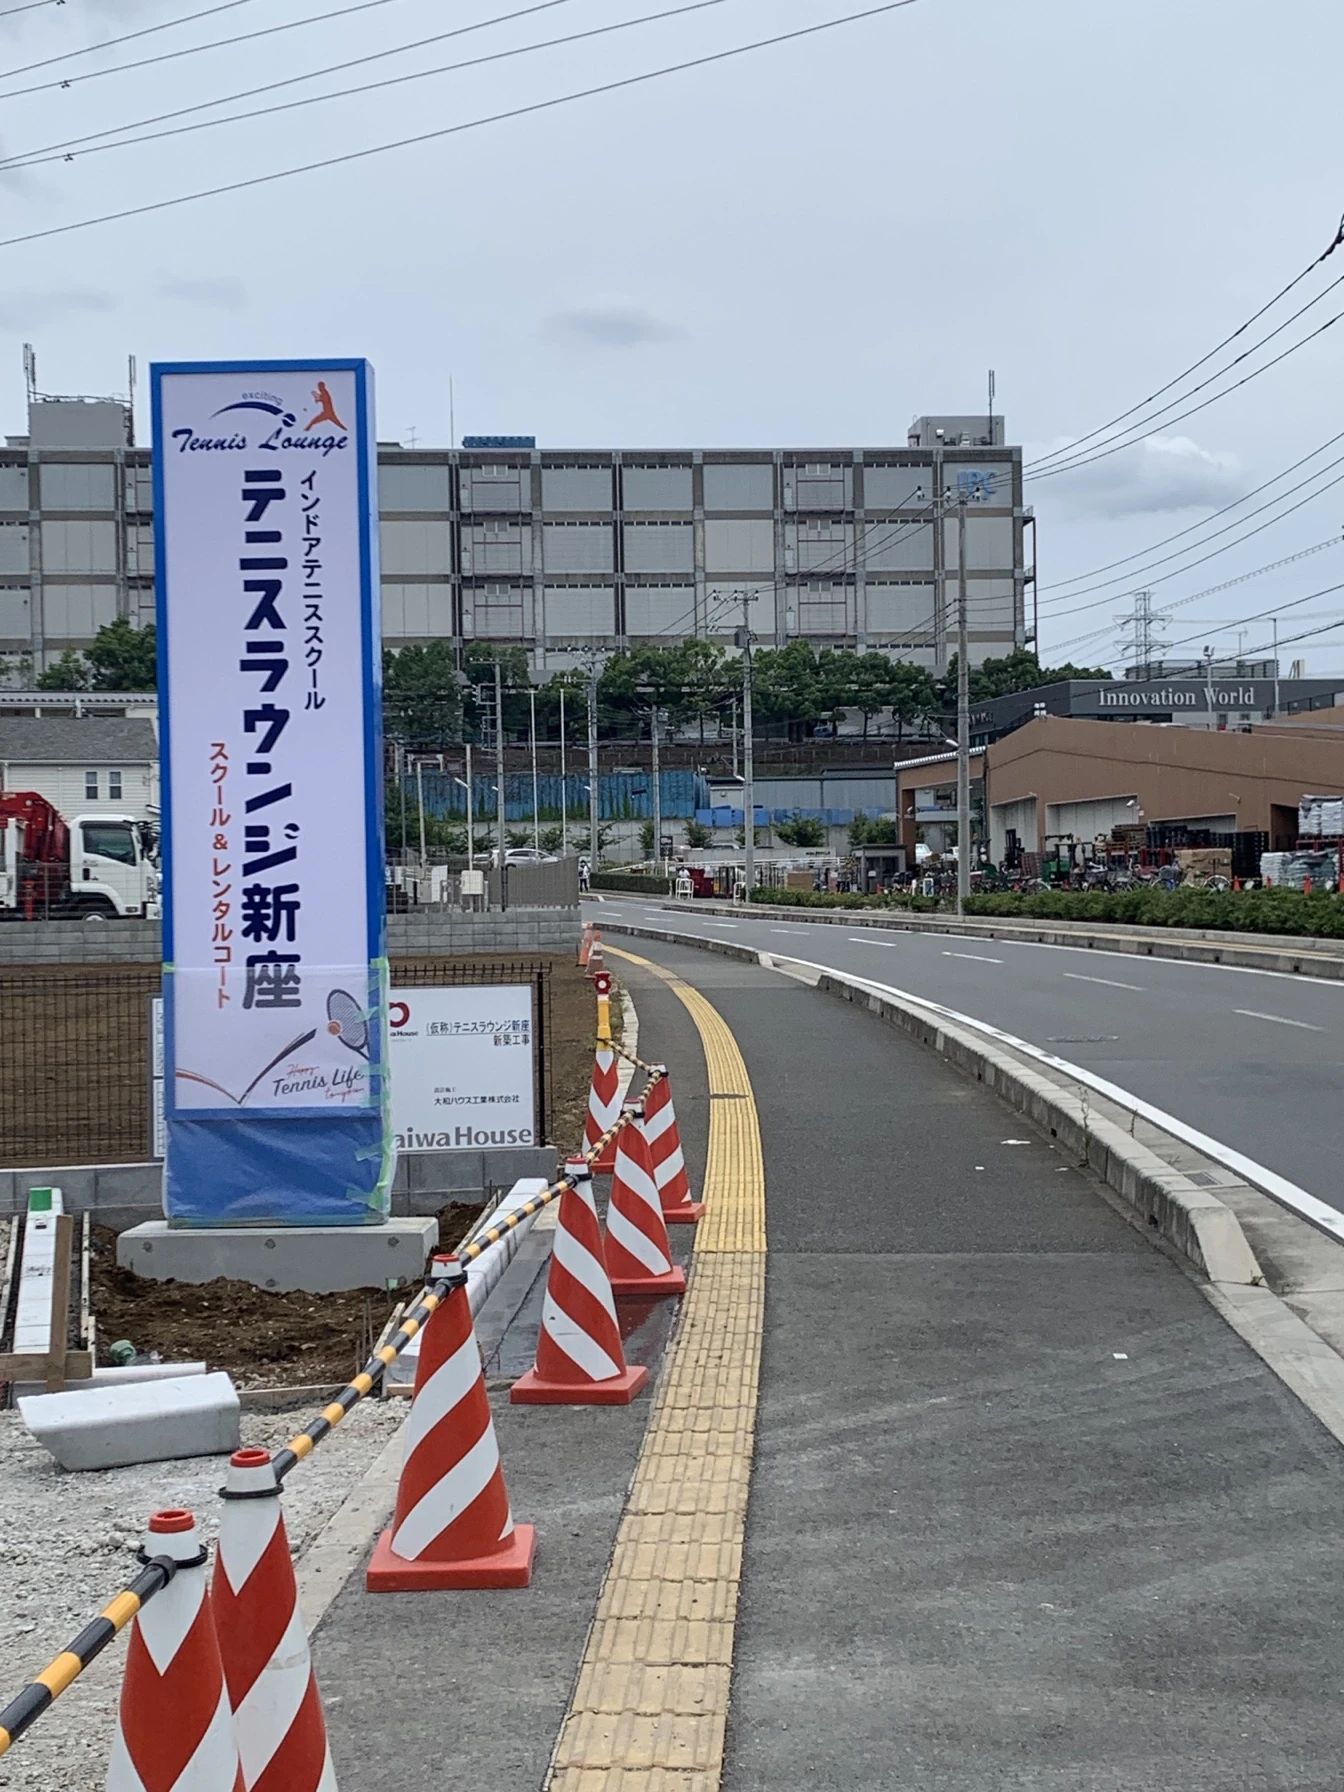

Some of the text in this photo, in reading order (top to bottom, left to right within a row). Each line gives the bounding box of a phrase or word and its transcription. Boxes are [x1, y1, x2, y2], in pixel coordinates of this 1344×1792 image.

[242, 391, 284, 406] exciting
[171, 427, 348, 457] Tennis Lounge
[300, 470, 326, 710] インドアテニススクール
[1099, 687, 1255, 706] Innovation World
[239, 469, 302, 1010] テニスラウンジ新座
[208, 742, 233, 1009] スクール&レンタルコート
[272, 1065, 366, 1097] Tennis Life
[395, 1126, 532, 1149] aiwa House
